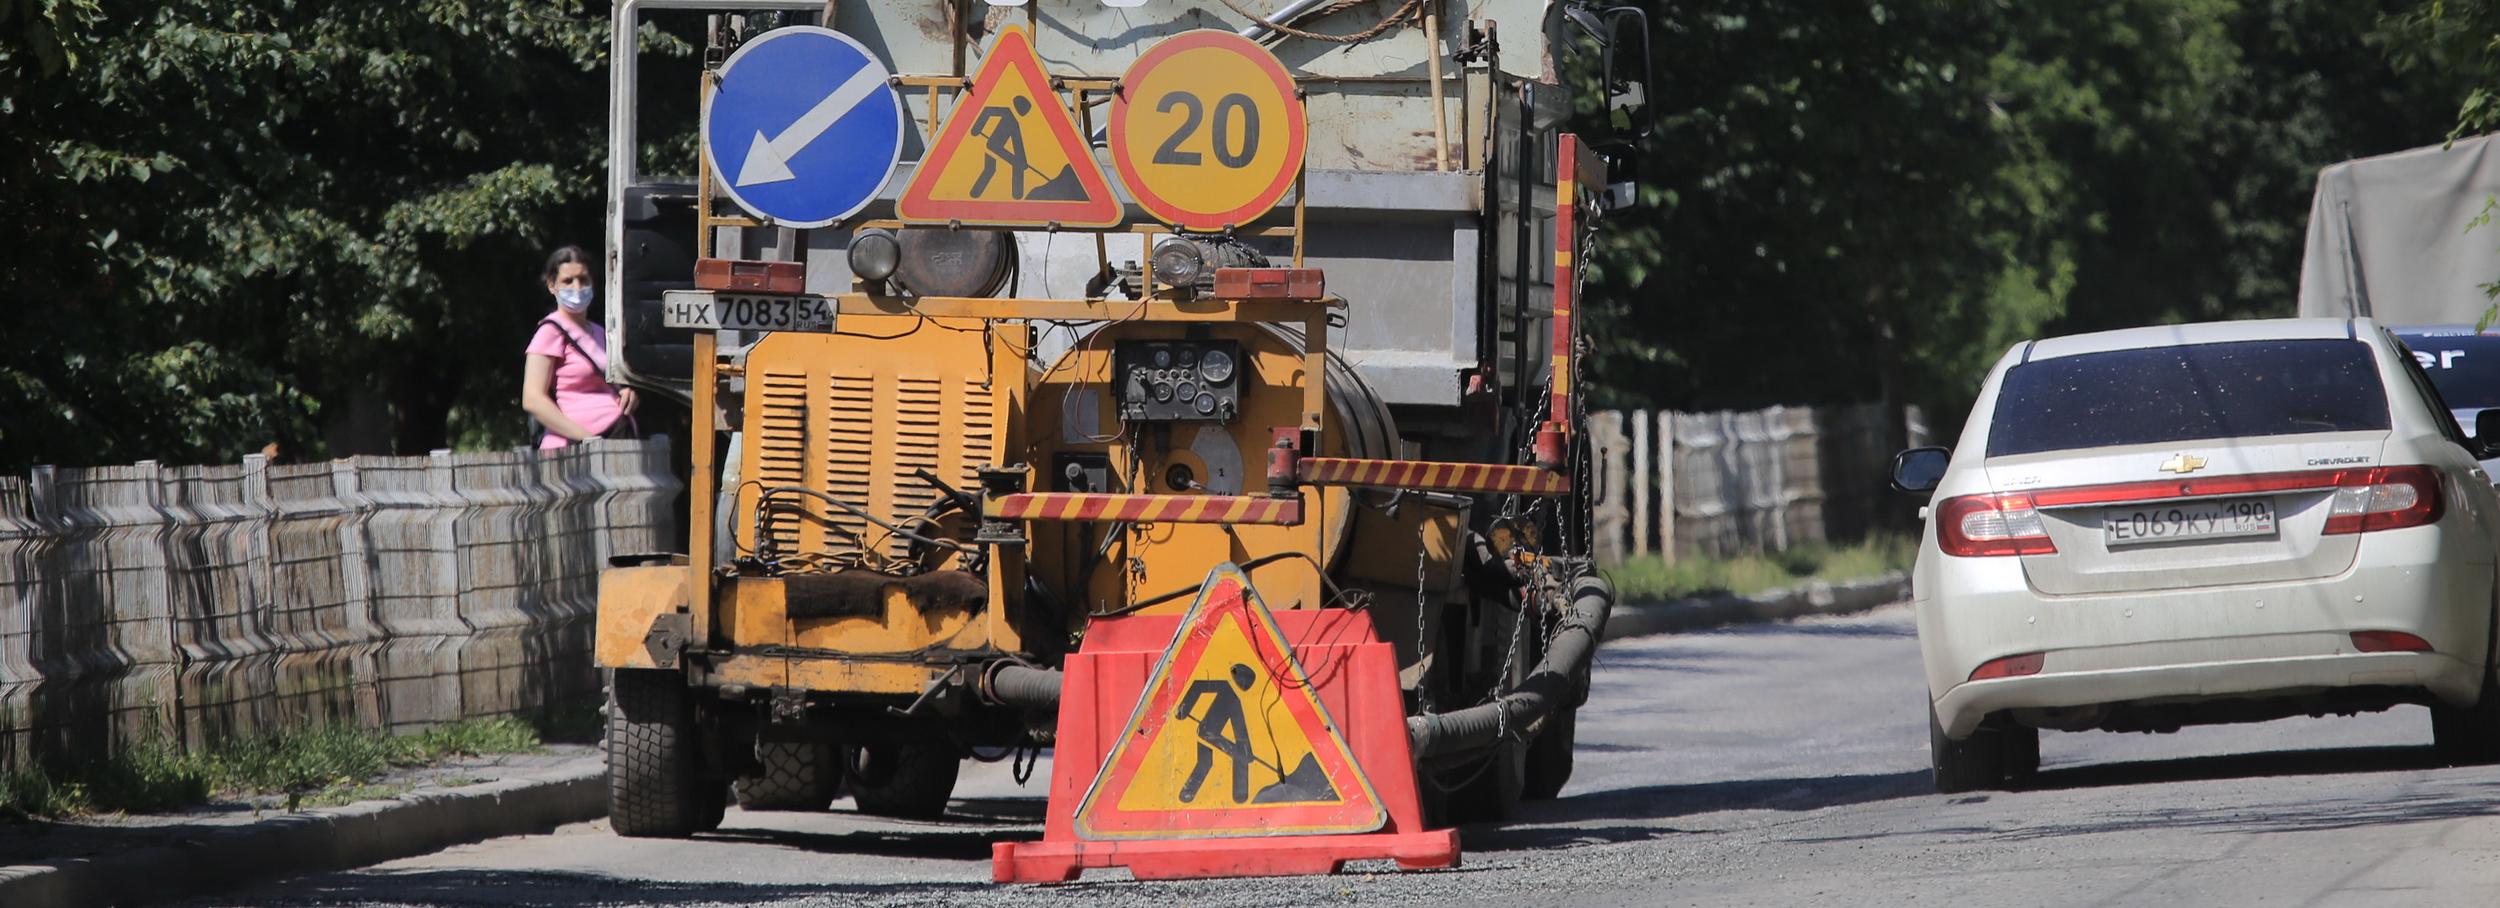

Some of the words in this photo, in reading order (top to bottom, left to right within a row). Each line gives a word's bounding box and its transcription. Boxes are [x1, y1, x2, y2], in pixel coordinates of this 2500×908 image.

[1152, 91, 1260, 168] 20
[799, 299, 827, 320] 54
[2307, 456, 2370, 466] CHEVROLET
[2226, 502, 2265, 523] 190
[2236, 523, 2256, 532] RUS
